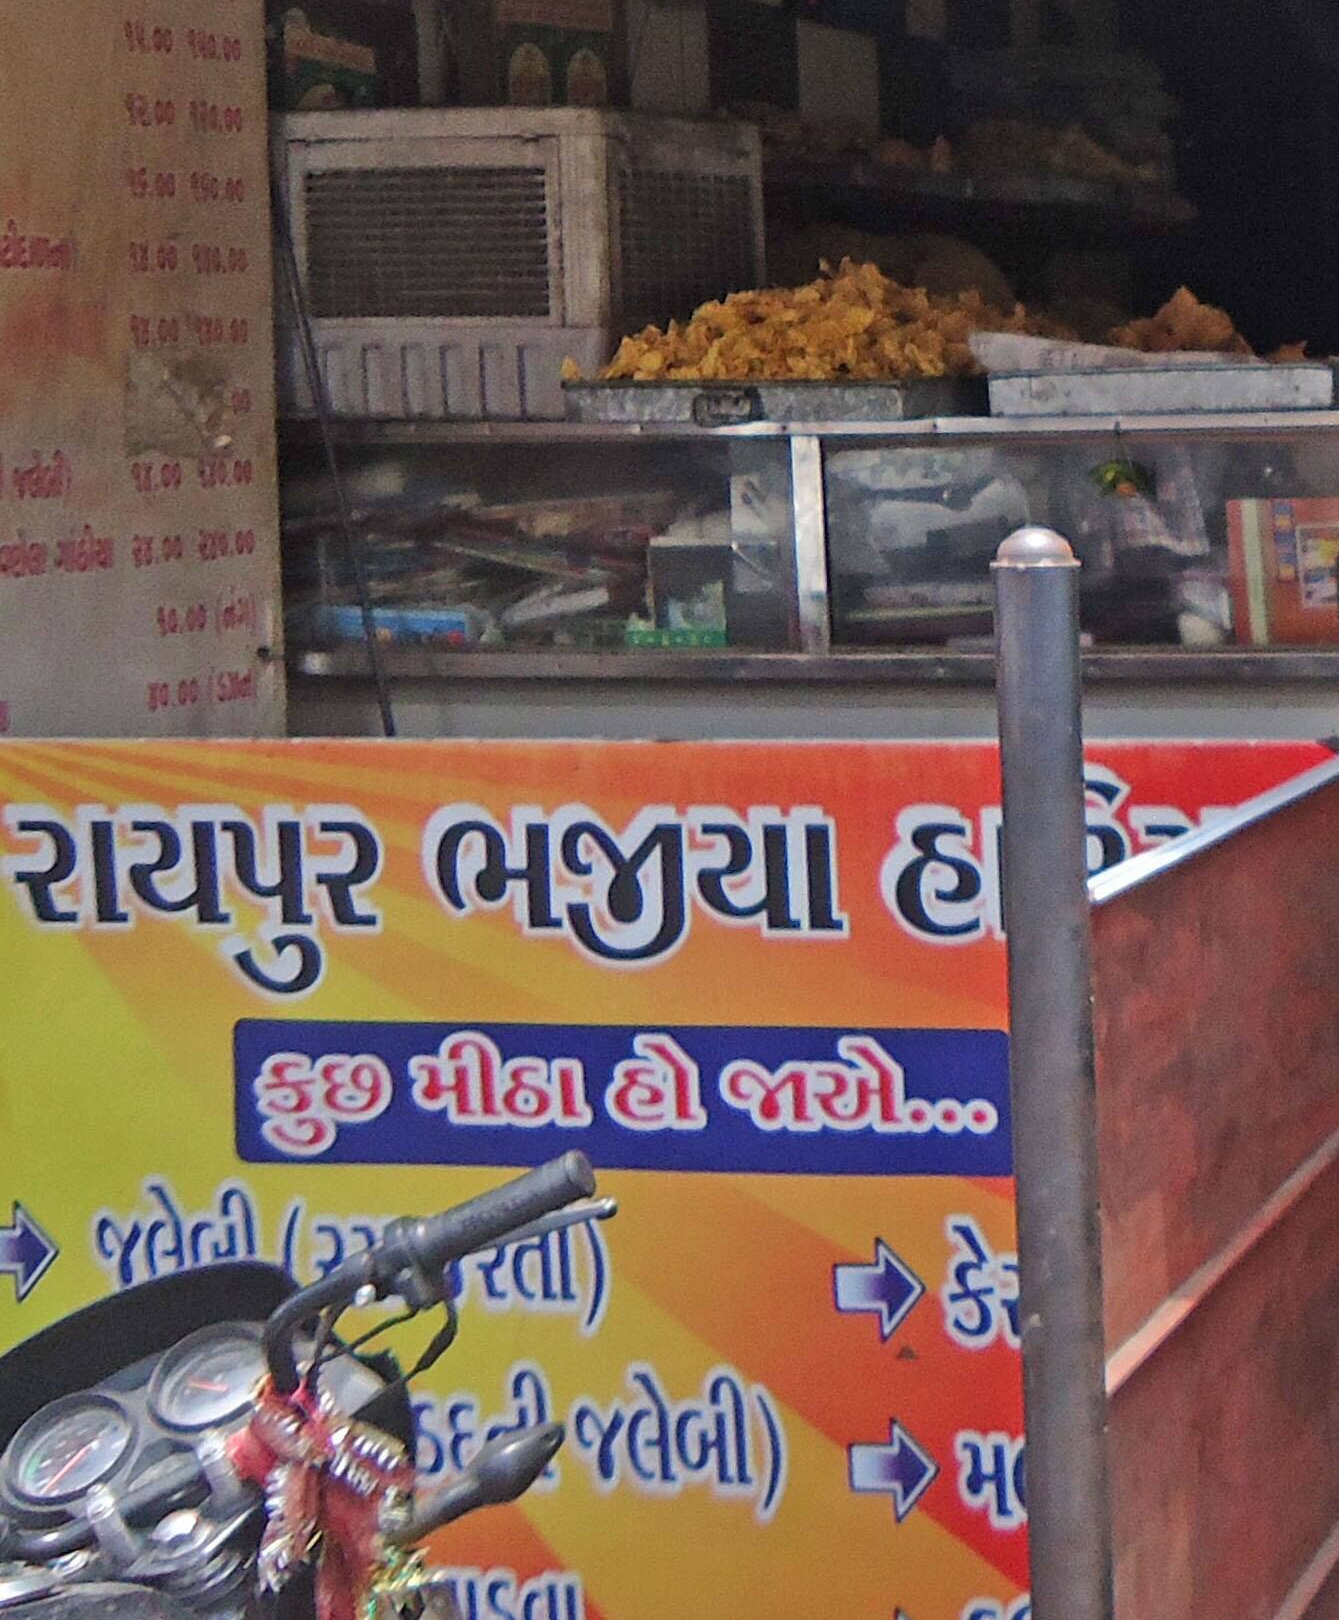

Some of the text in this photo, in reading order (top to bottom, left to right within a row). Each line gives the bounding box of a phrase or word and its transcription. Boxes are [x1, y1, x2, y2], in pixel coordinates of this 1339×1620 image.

[12, 812, 384, 995] રાયપુર
[432, 812, 848, 963] ભજીયા
[256, 1052, 390, 1155] કુછ
[413, 1032, 591, 1128] મીઠા
[607, 1033, 706, 1130] હો
